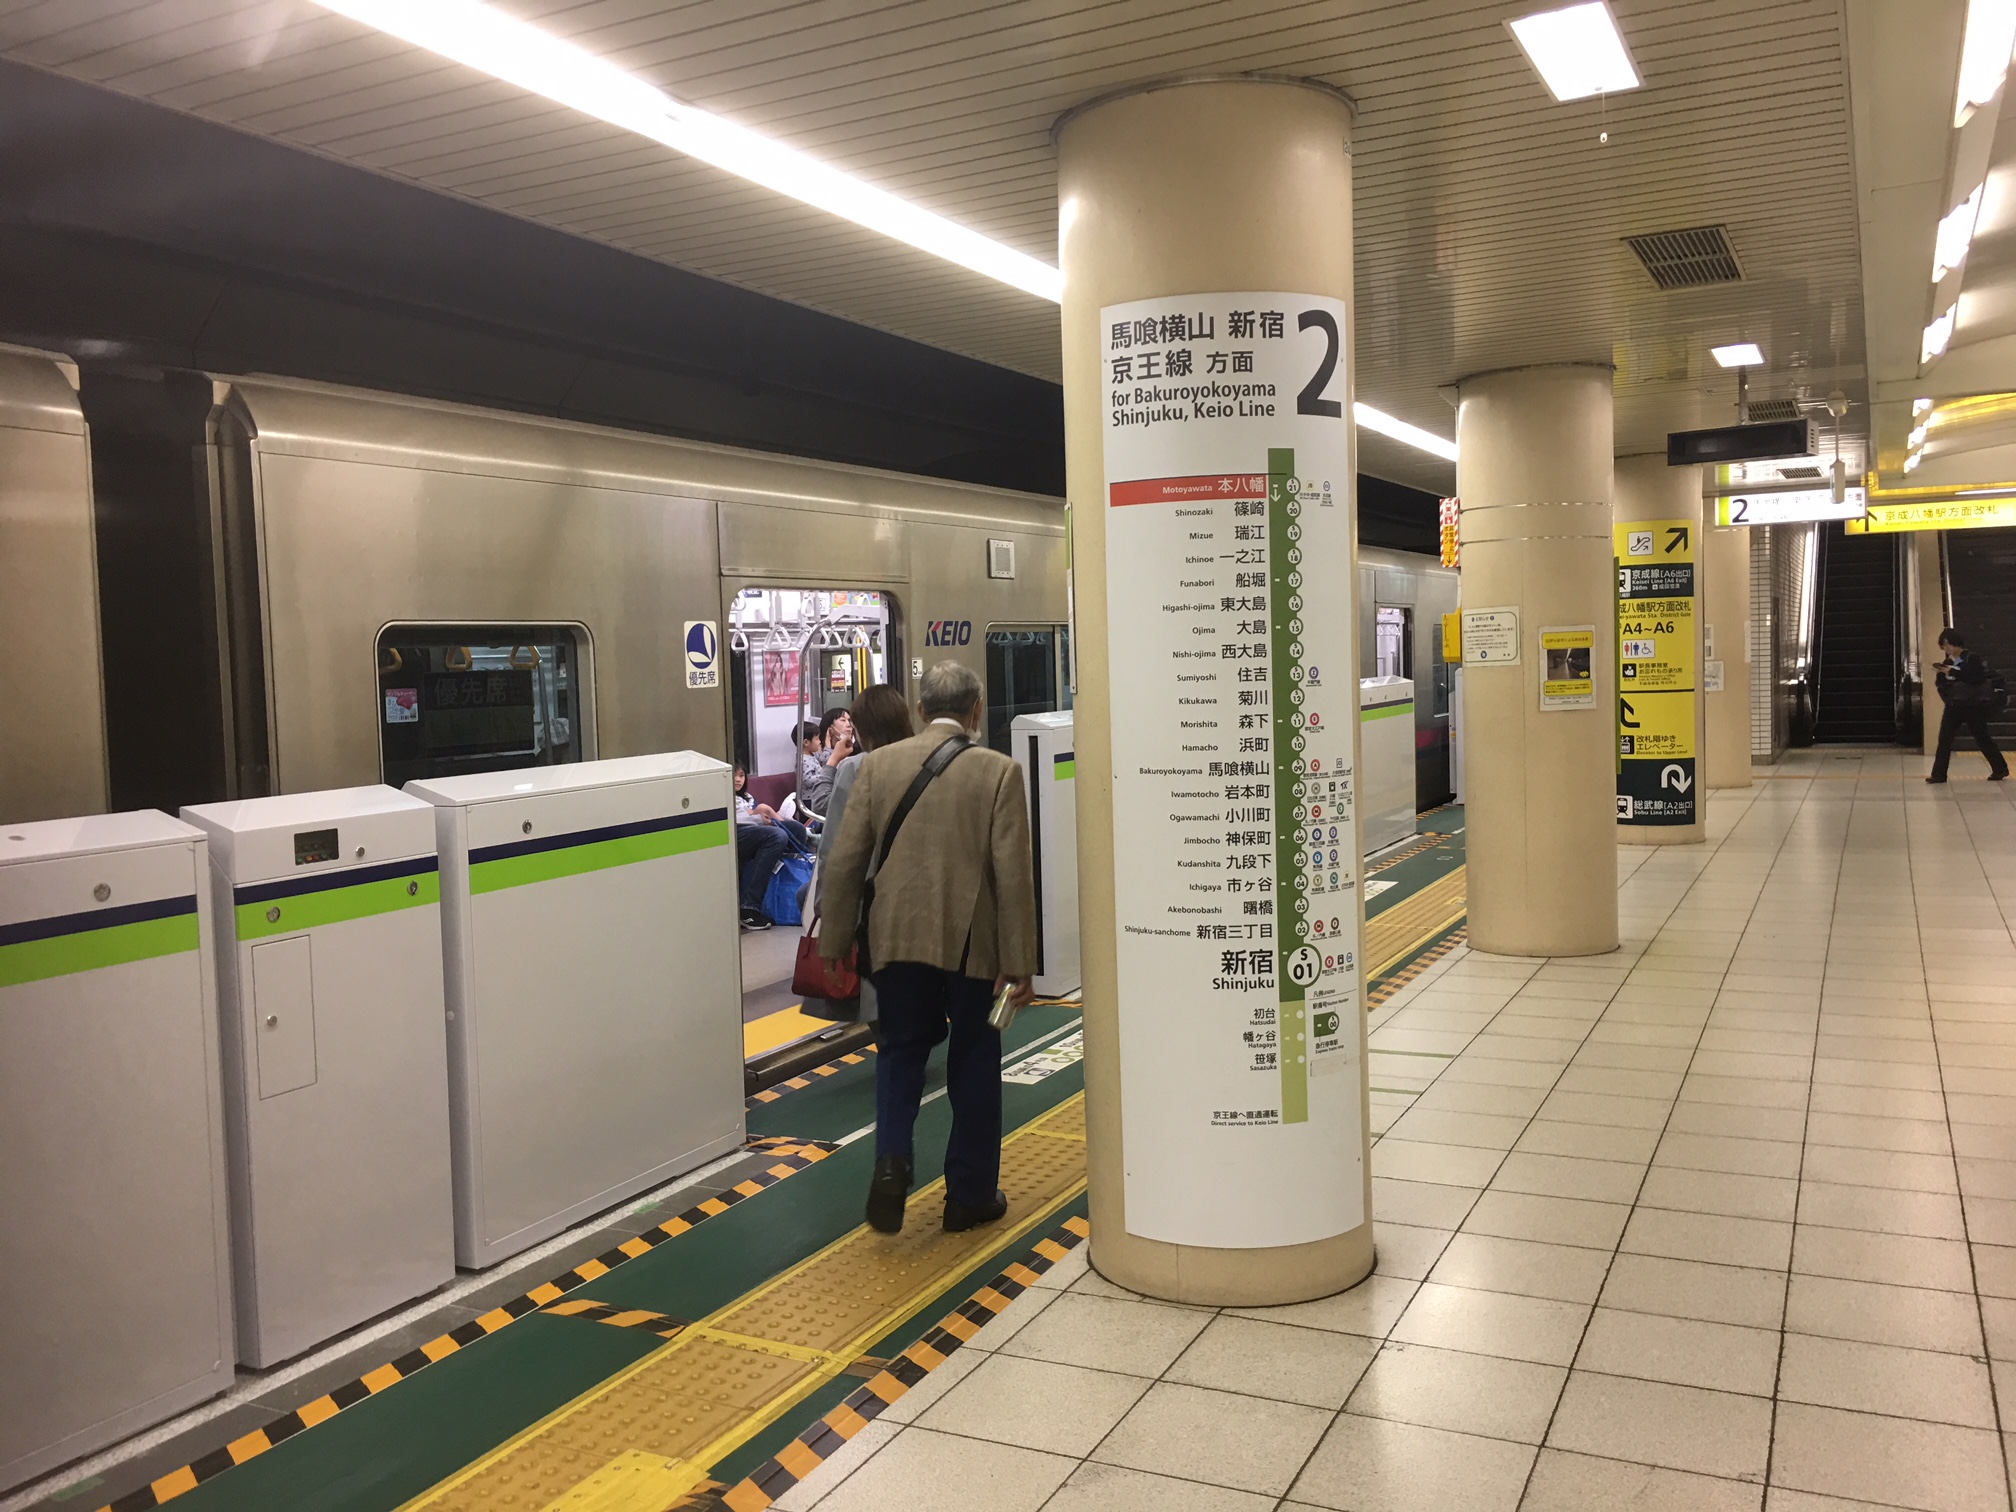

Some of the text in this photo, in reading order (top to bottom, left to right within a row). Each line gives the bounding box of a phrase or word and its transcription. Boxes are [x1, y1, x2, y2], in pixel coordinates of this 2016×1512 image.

[1111, 310, 1284, 350] 馬喰横山 新宿
[1111, 348, 1253, 384] 京王線 方面
[1296, 309, 1341, 419] 2
[1111, 381, 1276, 407] for Bakuroyokoyama
[1112, 400, 1275, 428] Shinjuku, Keio Line
[1162, 483, 1213, 495] Motoyawata
[1217, 476, 1264, 493] 本八幡
[1175, 507, 1213, 517] Shinozaki
[1234, 500, 1265, 517] 篠崎
[1732, 498, 1749, 523] 2
[1885, 505, 1998, 521] 京成八幡駅方面改札
[1189, 531, 1214, 540] Mizue
[1234, 524, 1265, 541] 瑞江
[1185, 555, 1214, 564] Ichinoe
[1219, 548, 1266, 564] 一之江
[1180, 579, 1215, 588] Funabori
[1235, 572, 1266, 588] 船堀
[1162, 603, 1215, 614] Higashi-ojima
[1220, 596, 1266, 612] 東大島
[925, 620, 972, 647] KEIO
[1192, 626, 1216, 636] Ojima
[1236, 619, 1267, 635] 大島
[1172, 649, 1216, 661] Nishi-ojima
[1221, 642, 1267, 660] 西大島
[912, 661, 918, 676] 5
[1237, 666, 1268, 683] 住吉
[689, 671, 715, 686] 優先席
[1176, 673, 1217, 683] Sumiyoshi
[435, 676, 508, 706] 優先席
[1238, 690, 1268, 706] 菊川
[1178, 697, 1218, 705] Kikukawa
[1180, 720, 1218, 729] Morishita
[1238, 713, 1269, 729] 森下
[1239, 737, 1269, 753] 浜町
[1636, 735, 1677, 743] 改札階ゆき
[1182, 743, 1218, 752] Hamacho
[1636, 743, 1684, 751] エレベーター
[1139, 767, 1203, 777] Bakuroyokoyama
[1208, 761, 1270, 777] 馬喰横山
[1171, 790, 1220, 798] Iwamotocho
[1224, 784, 1270, 800] 岩本町
[1169, 814, 1220, 823] Ogawamachi
[1225, 807, 1271, 823] 小川町
[1294, 811, 1304, 819] 07
[1183, 837, 1221, 846] Jimbocho
[1225, 831, 1271, 847] 神保町
[1177, 860, 1221, 868] Kudanshita
[1225, 853, 1272, 870] 九段下
[1189, 883, 1222, 892] Ichigaya
[1167, 906, 1222, 914] Akebonobashi
[1243, 899, 1273, 916] 曙橋
[1124, 925, 1191, 937] Shinjuku-sanchome
[1196, 923, 1273, 940] 新宿三丁目
[1221, 948, 1273, 975] 新宿
[1300, 948, 1308, 961] S
[1293, 963, 1312, 980] 01
[1212, 976, 1275, 993] Shinjuku
[1253, 1007, 1276, 1020] 初台
[1329, 1021, 1337, 1029] 00
[1248, 1042, 1277, 1050] Hatagaya
[1255, 1053, 1277, 1065] 笹塚
[1213, 1109, 1279, 1119] 京王線へ直通運転
